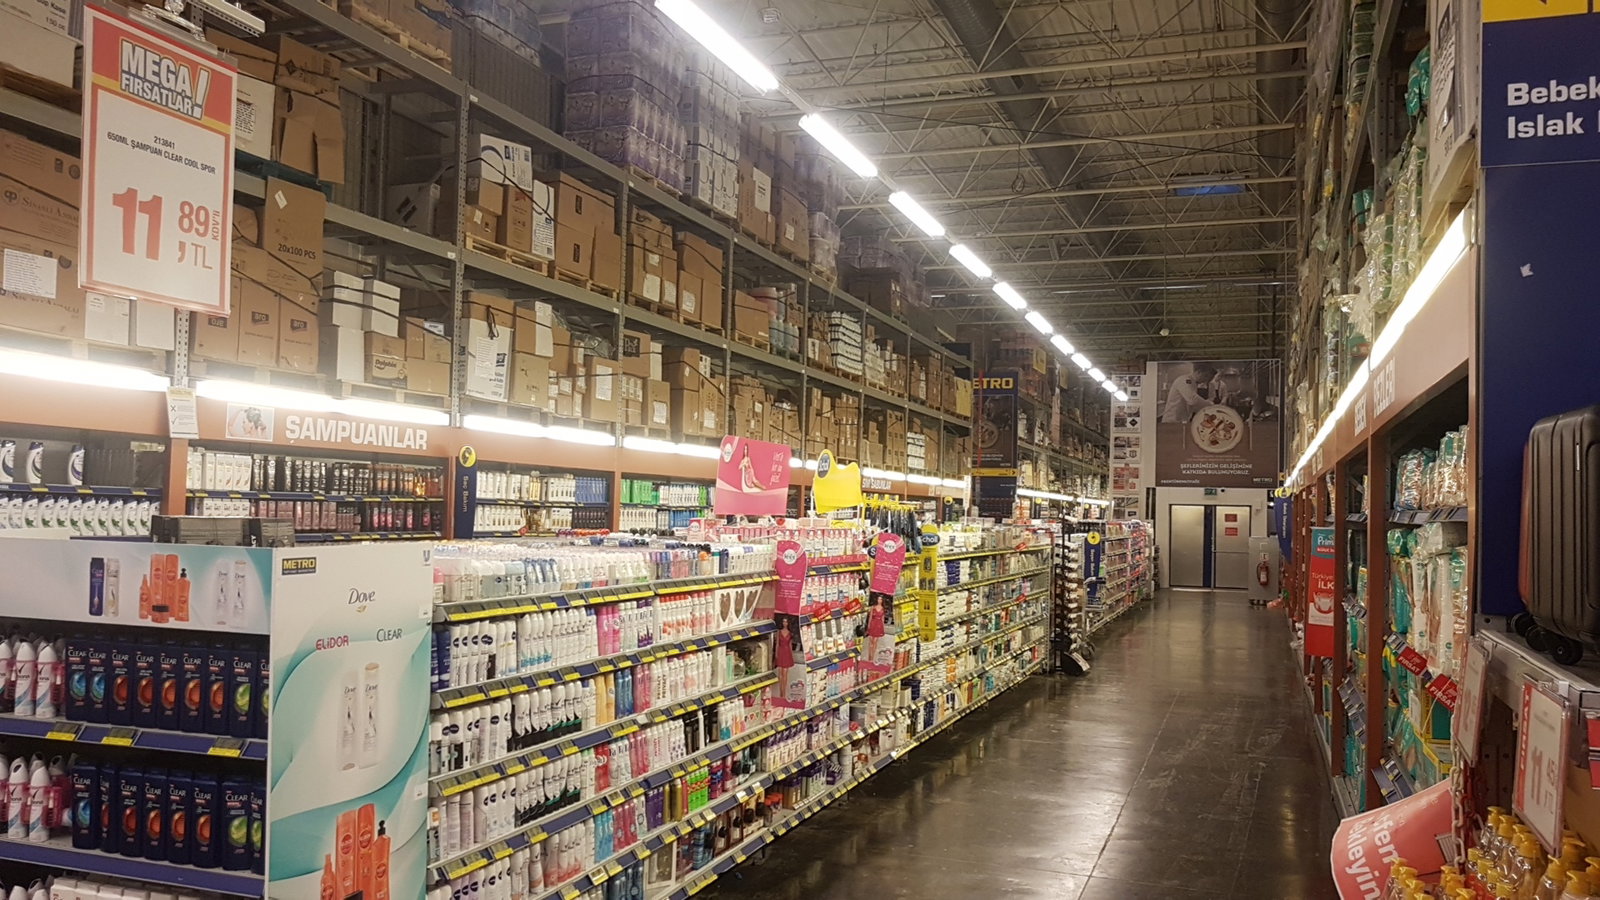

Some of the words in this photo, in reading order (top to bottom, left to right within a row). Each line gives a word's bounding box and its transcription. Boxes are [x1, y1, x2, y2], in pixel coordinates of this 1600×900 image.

[122, 40, 193, 98] MEGA
[1507, 76, 1600, 106] Bebek
[1507, 112, 1584, 139] Islak
[154, 136, 175, 149] 213841
[107, 132, 129, 146] 650ML
[131, 140, 162, 156] ŞAMPUAN
[164, 151, 183, 163] CLEAR
[184, 158, 199, 170] COOL
[201, 164, 216, 174] SPOR
[112, 187, 163, 261] 11
[178, 201, 210, 237] 89
[191, 242, 213, 270] TL
[278, 243, 303, 256] 20x100
[304, 249, 316, 260] PCS
[973, 378, 1013, 389] ETRO
[285, 415, 428, 450] ŞAMPUANLAR
[283, 559, 316, 569] METRO
[348, 588, 376, 605] Dove
[376, 628, 402, 643] CLEAR
[233, 660, 251, 669] CLEAR
[1398, 656, 1421, 674] FIRSAT
[225, 794, 248, 802] CLEAR
